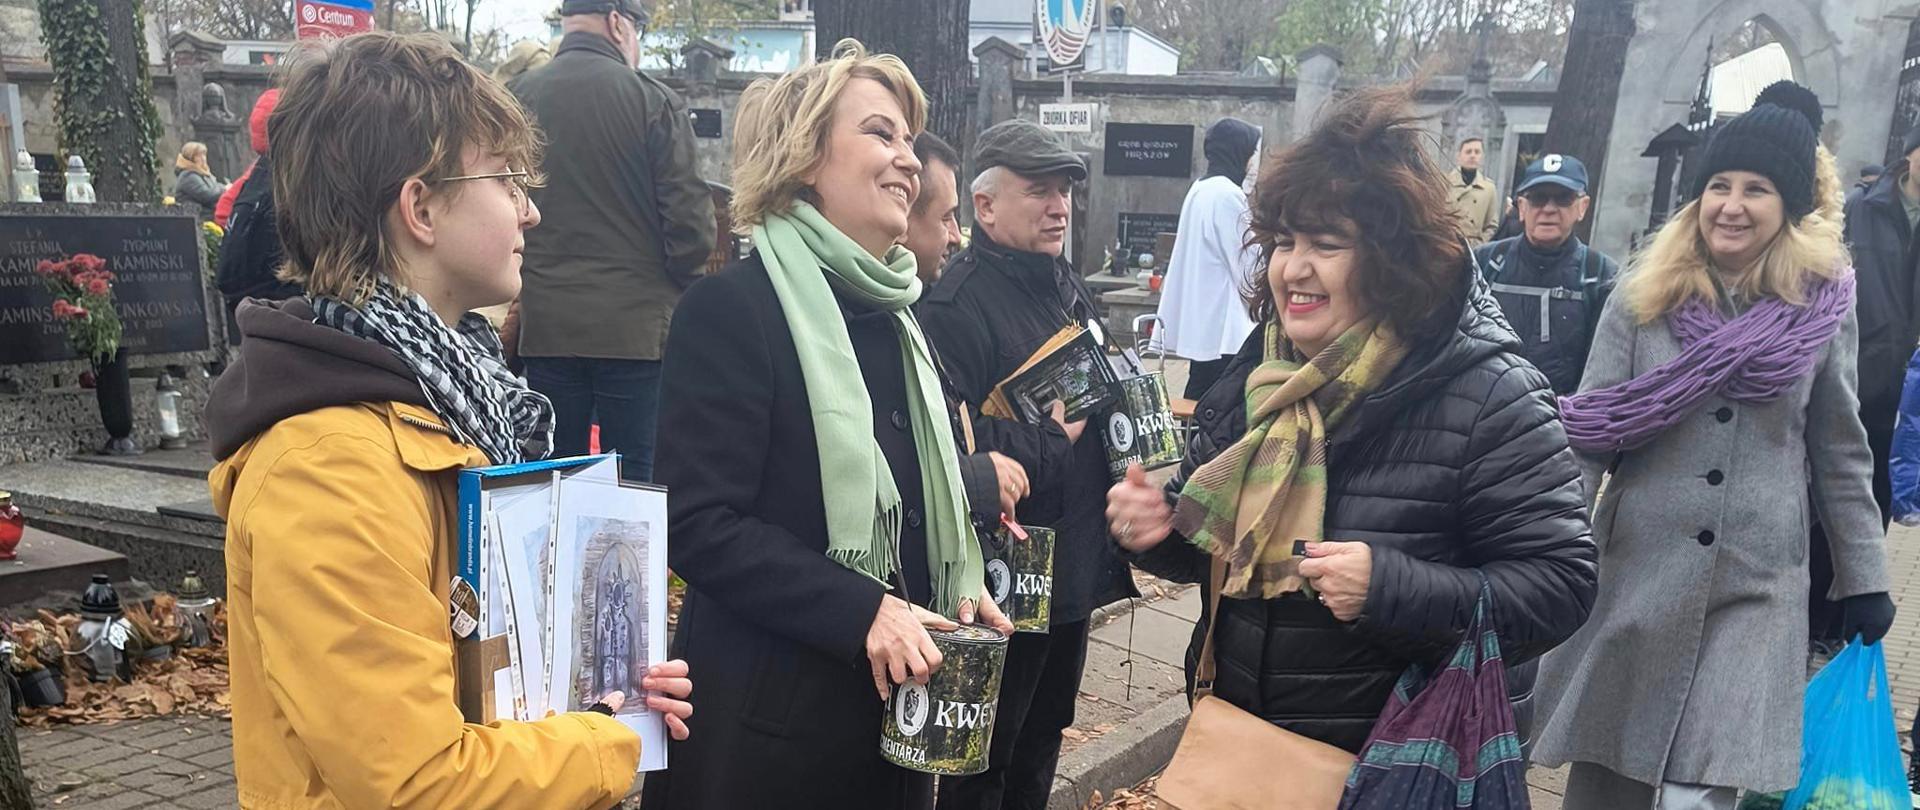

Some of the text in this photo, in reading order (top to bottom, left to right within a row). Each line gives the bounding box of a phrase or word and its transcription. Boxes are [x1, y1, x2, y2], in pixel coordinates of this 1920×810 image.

[318, 6, 354, 27] Centrum
[1069, 110, 1088, 125] OFIAR
[1544, 154, 1562, 172] C
[9, 241, 63, 255] STEFANIA
[121, 240, 168, 252] ZYGMUNT
[1135, 411, 1175, 437] KWE
